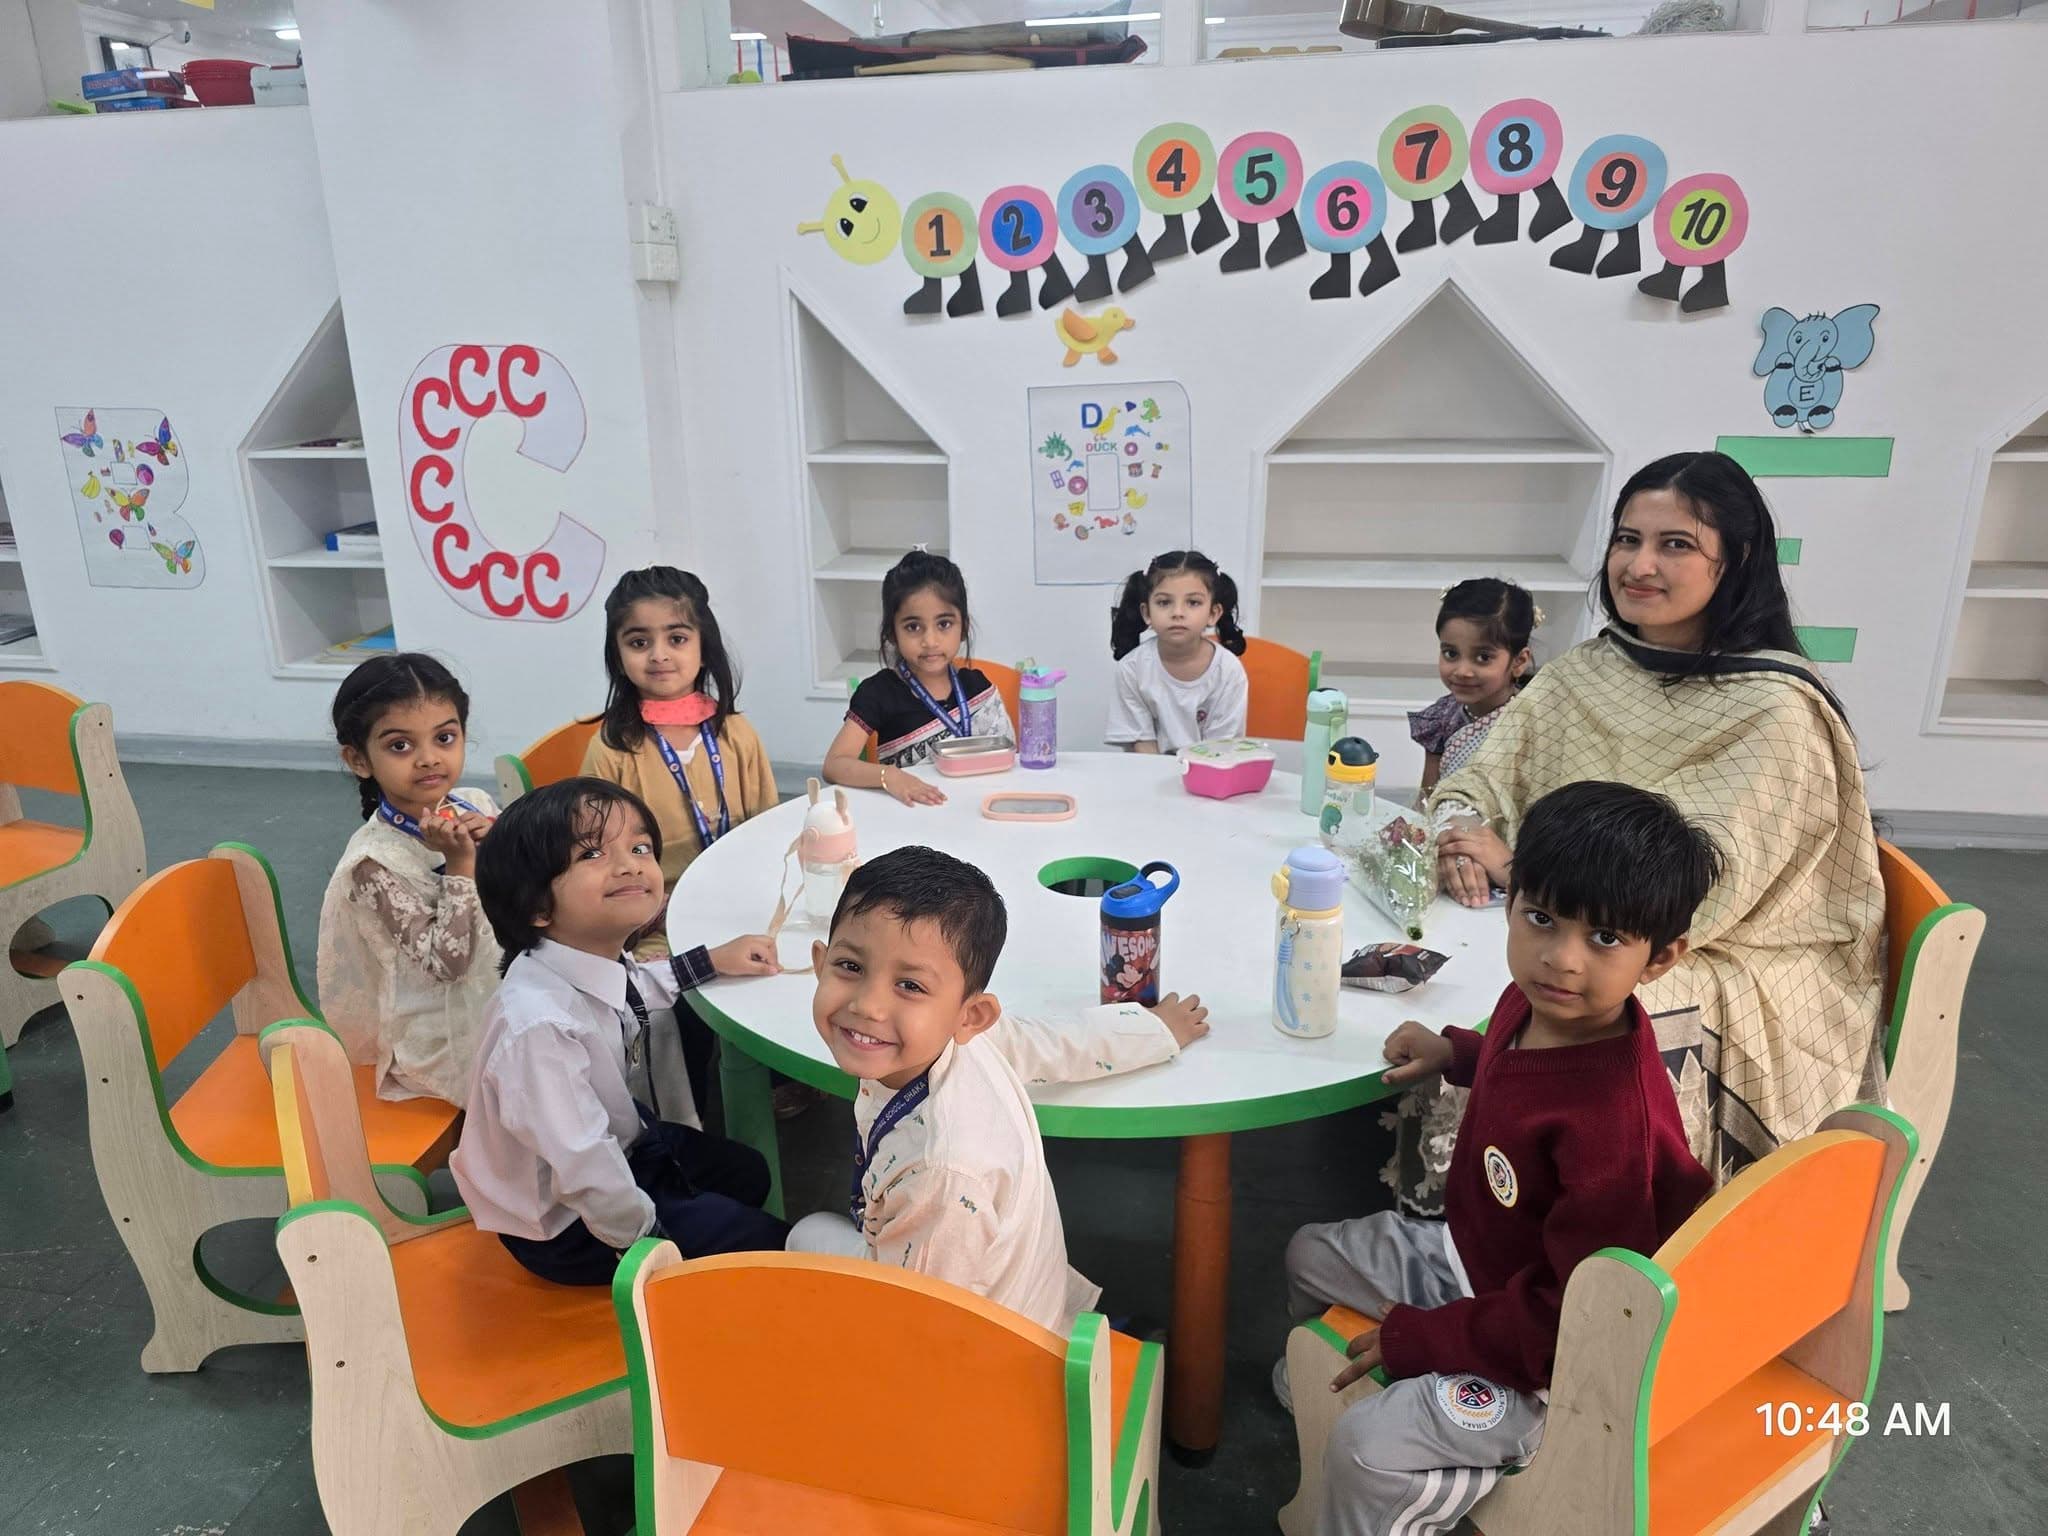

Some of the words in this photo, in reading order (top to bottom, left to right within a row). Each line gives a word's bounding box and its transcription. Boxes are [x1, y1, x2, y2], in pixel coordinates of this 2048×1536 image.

[927, 214, 951, 257] 1
[1002, 205, 1032, 251] 2
[1084, 188, 1114, 232] 3
[1156, 148, 1187, 192] 4
[1245, 153, 1277, 206] 5
[1327, 184, 1360, 231] 6
[1404, 129, 1439, 180] 7
[1498, 123, 1533, 172] 8
[1595, 158, 1637, 208] 9
[1680, 198, 1727, 245] 10
[412, 377, 461, 451] C
[449, 344, 497, 418] C
[498, 344, 546, 418] C
[1799, 384, 1815, 402] E
[1081, 402, 1103, 429] D
[1086, 441, 1118, 453] DUCK
[410, 454, 454, 524] C
[432, 522, 481, 590] C
[480, 551, 525, 617] C
[523, 552, 569, 619] C
[903, 1081, 927, 1102] DHAKA
